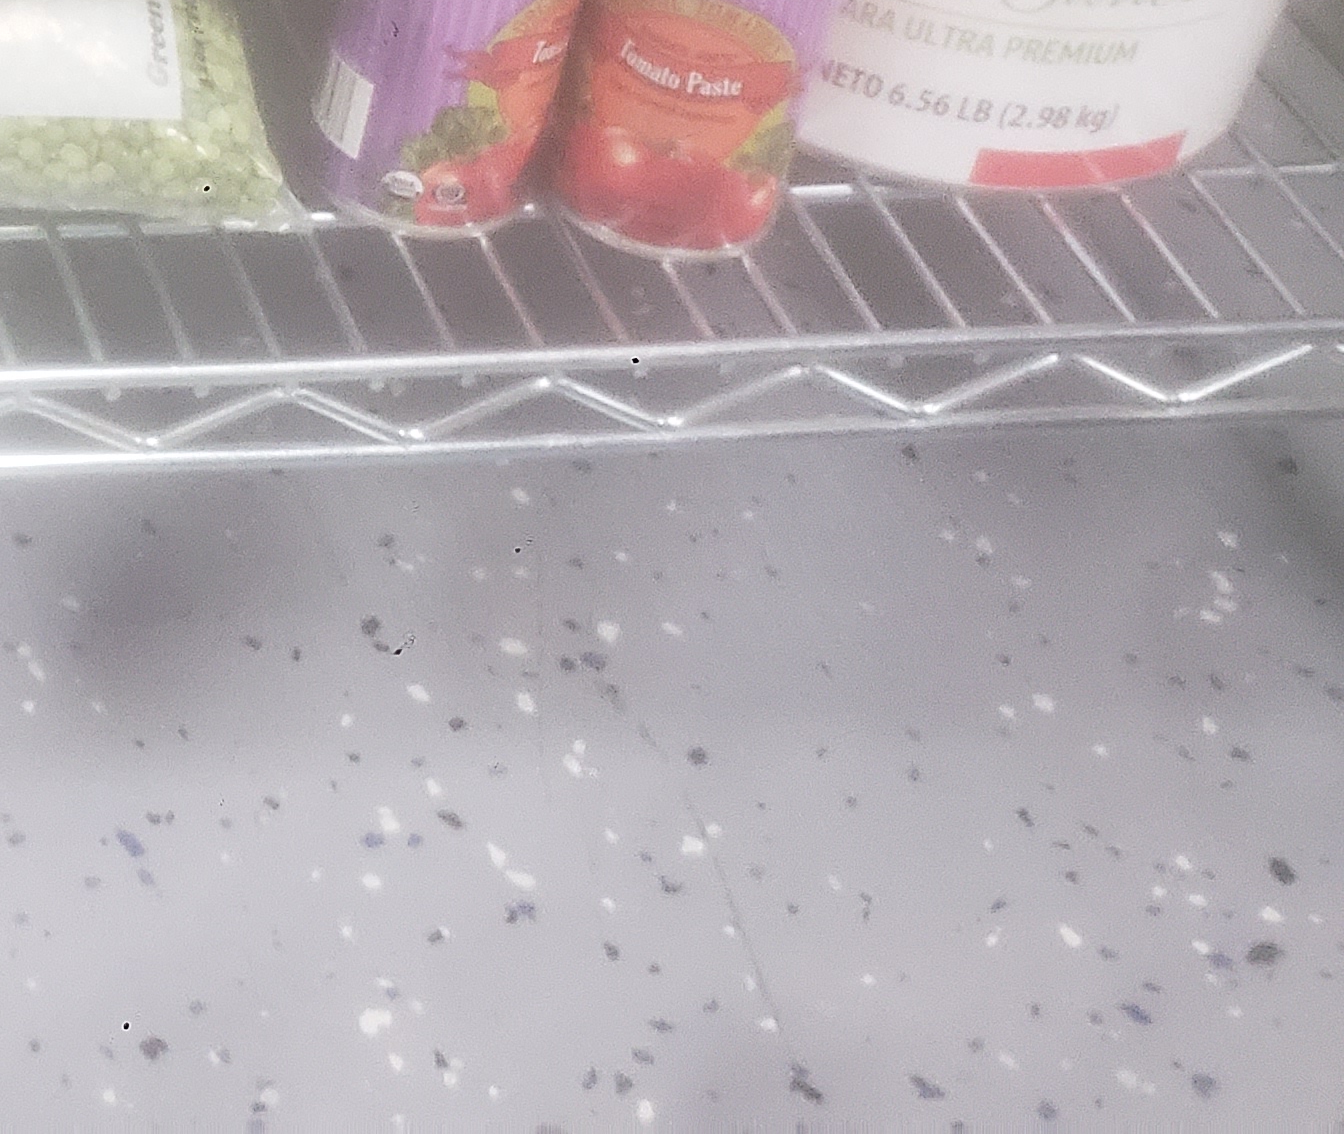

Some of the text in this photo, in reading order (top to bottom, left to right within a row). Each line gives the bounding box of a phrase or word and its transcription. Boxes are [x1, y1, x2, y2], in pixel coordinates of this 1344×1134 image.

[904, 15, 995, 57] ULTRA
[1003, 34, 1141, 65] PREMIUM
[619, 37, 682, 90] Tomato
[685, 69, 744, 97] Paste
[887, 82, 950, 116] 6.56
[956, 96, 994, 123] LB
[998, 102, 1072, 130] (2.98
